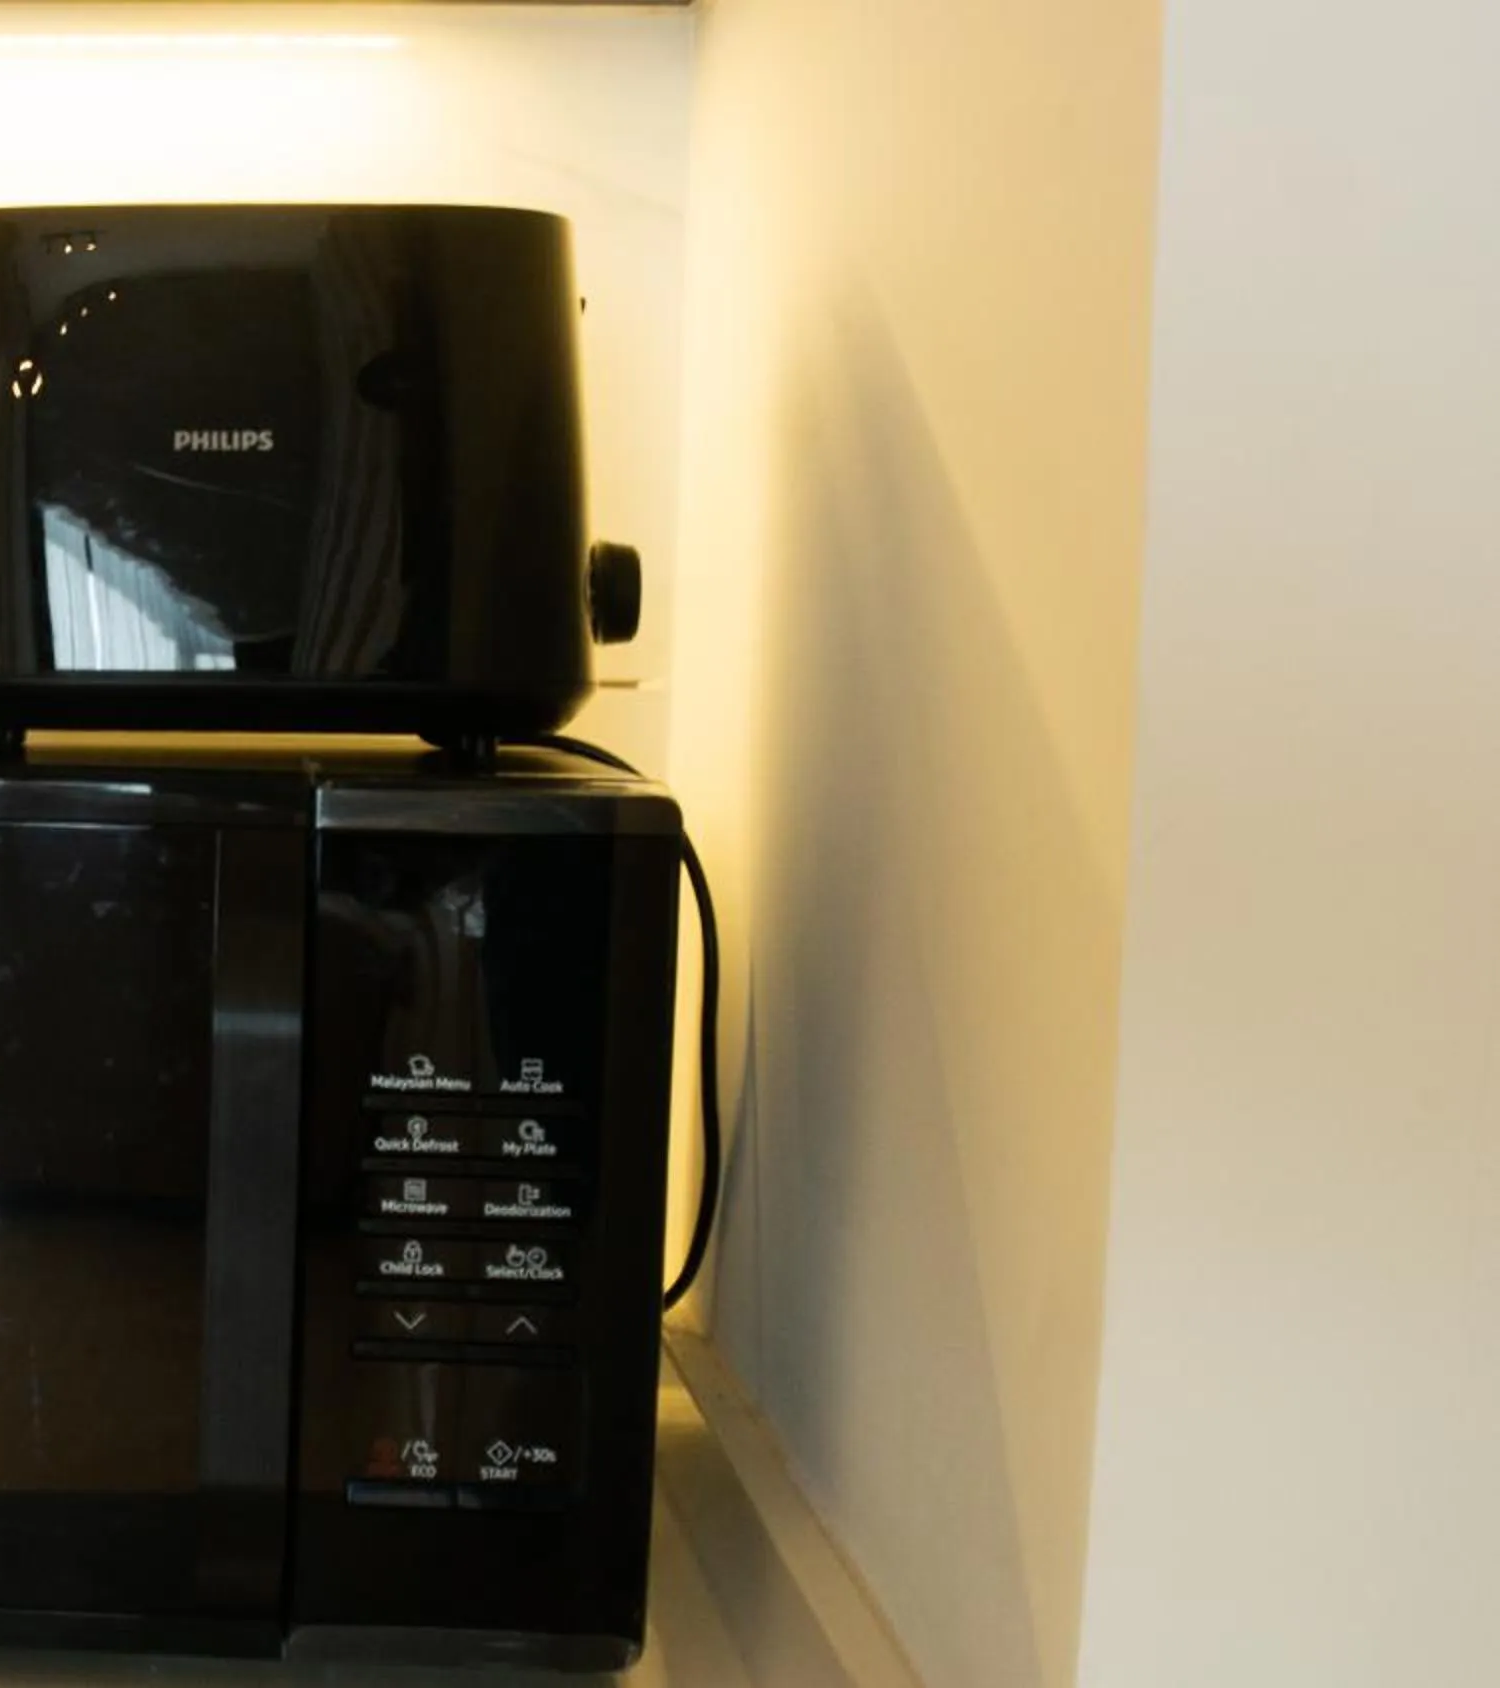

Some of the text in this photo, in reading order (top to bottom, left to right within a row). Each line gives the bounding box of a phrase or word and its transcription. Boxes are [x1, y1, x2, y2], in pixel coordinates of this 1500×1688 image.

[173, 429, 274, 452] PHILIPS
[370, 1074, 472, 1091] Malaysian Menu
[500, 1079, 564, 1093] Auto Cook
[374, 1136, 460, 1152] Quick Defrost
[503, 1141, 557, 1157] My Plate
[381, 1199, 449, 1214] Microwave
[484, 1202, 572, 1217] Deodorization
[379, 1260, 444, 1276] Child Lock
[485, 1264, 564, 1279] Select/Clock
[411, 1465, 437, 1478] ECO
[480, 1466, 519, 1480] START
